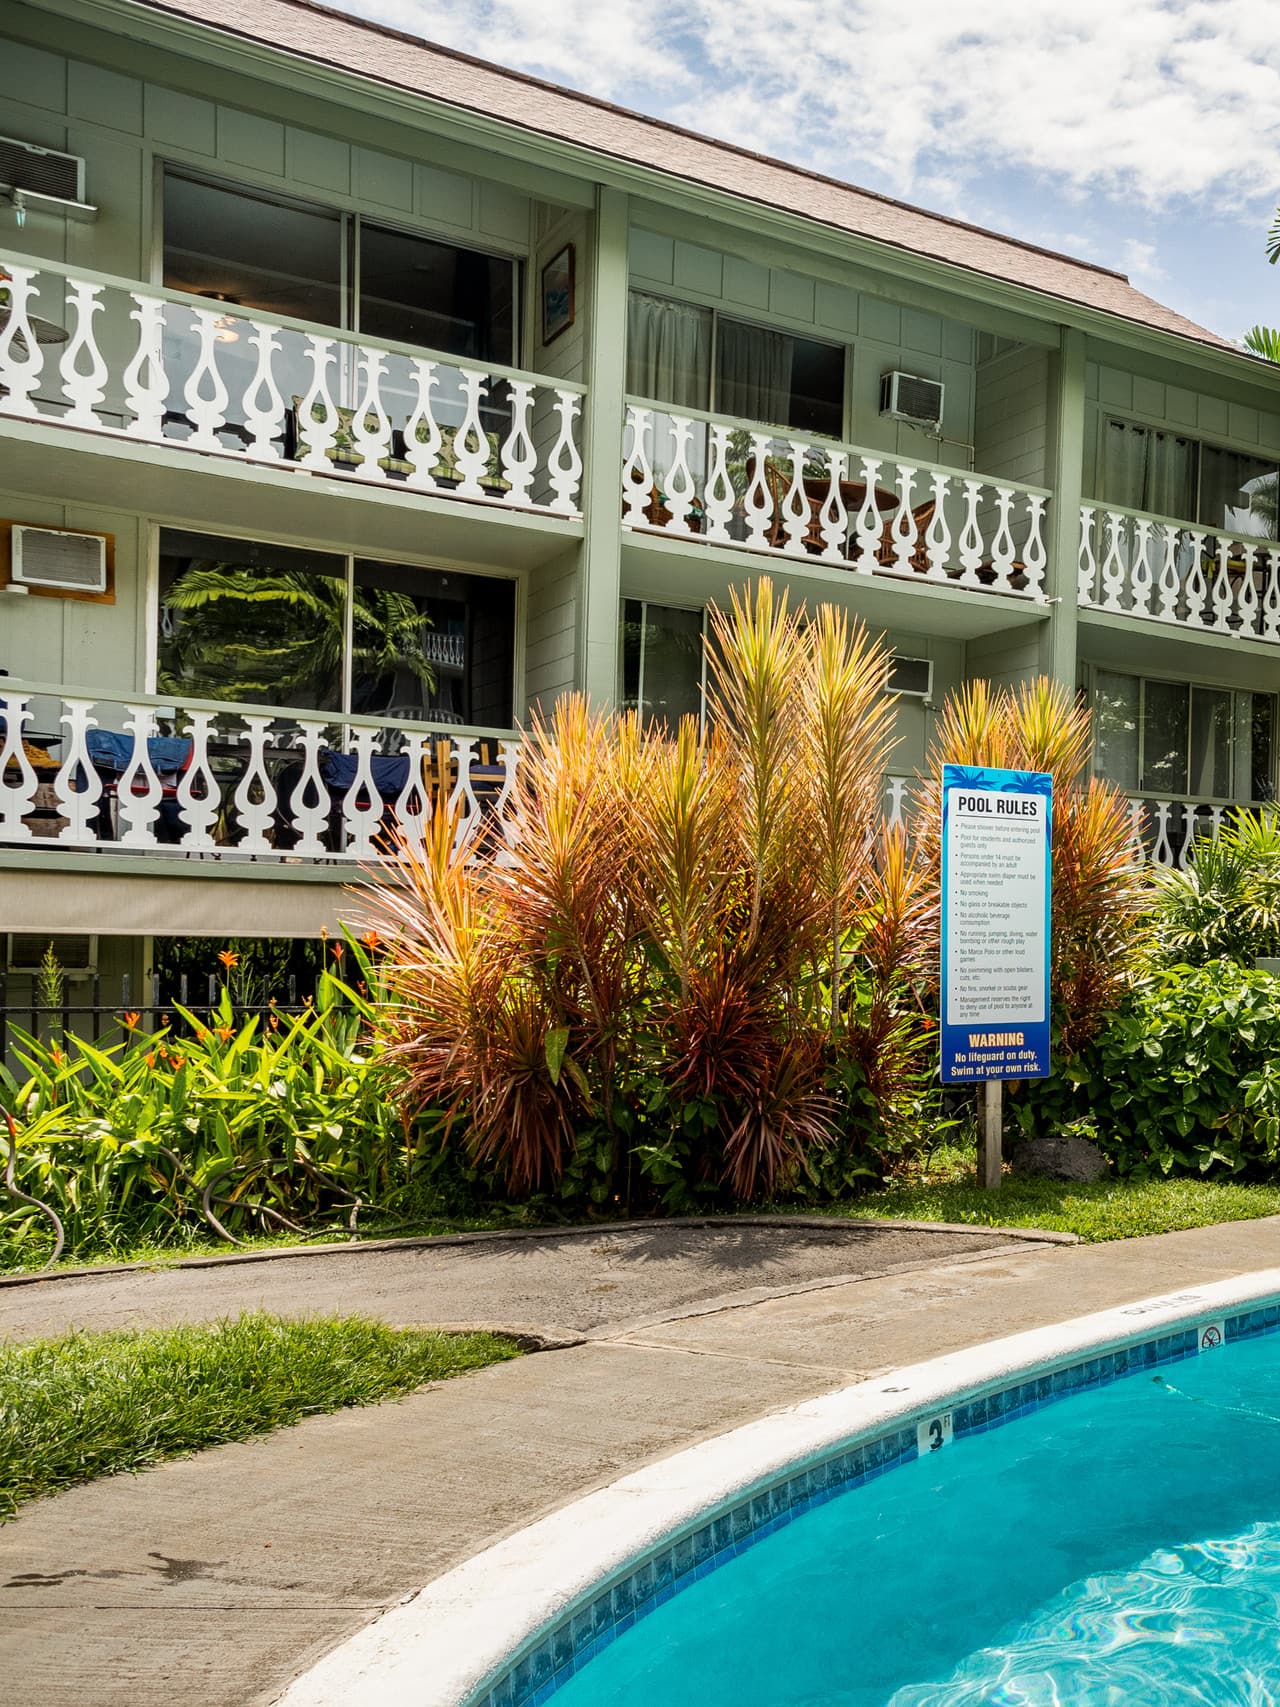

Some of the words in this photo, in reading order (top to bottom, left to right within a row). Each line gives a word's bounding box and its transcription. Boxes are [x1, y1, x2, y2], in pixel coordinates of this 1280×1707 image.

[959, 797, 992, 812] POOL
[997, 800, 1037, 816] RULES
[969, 1032, 1024, 1048] WARNING
[955, 1053, 966, 1062] No
[969, 1051, 1004, 1063] lifeguard
[1019, 1050, 1037, 1060] duty.
[951, 1066, 973, 1076] Swim
[976, 1066, 984, 1074] at
[986, 1065, 1003, 1076] your
[1006, 1064, 1021, 1072] own
[1024, 1062, 1041, 1072] risk.
[929, 1419, 944, 1450] 3
[944, 1414, 951, 1428] FT
